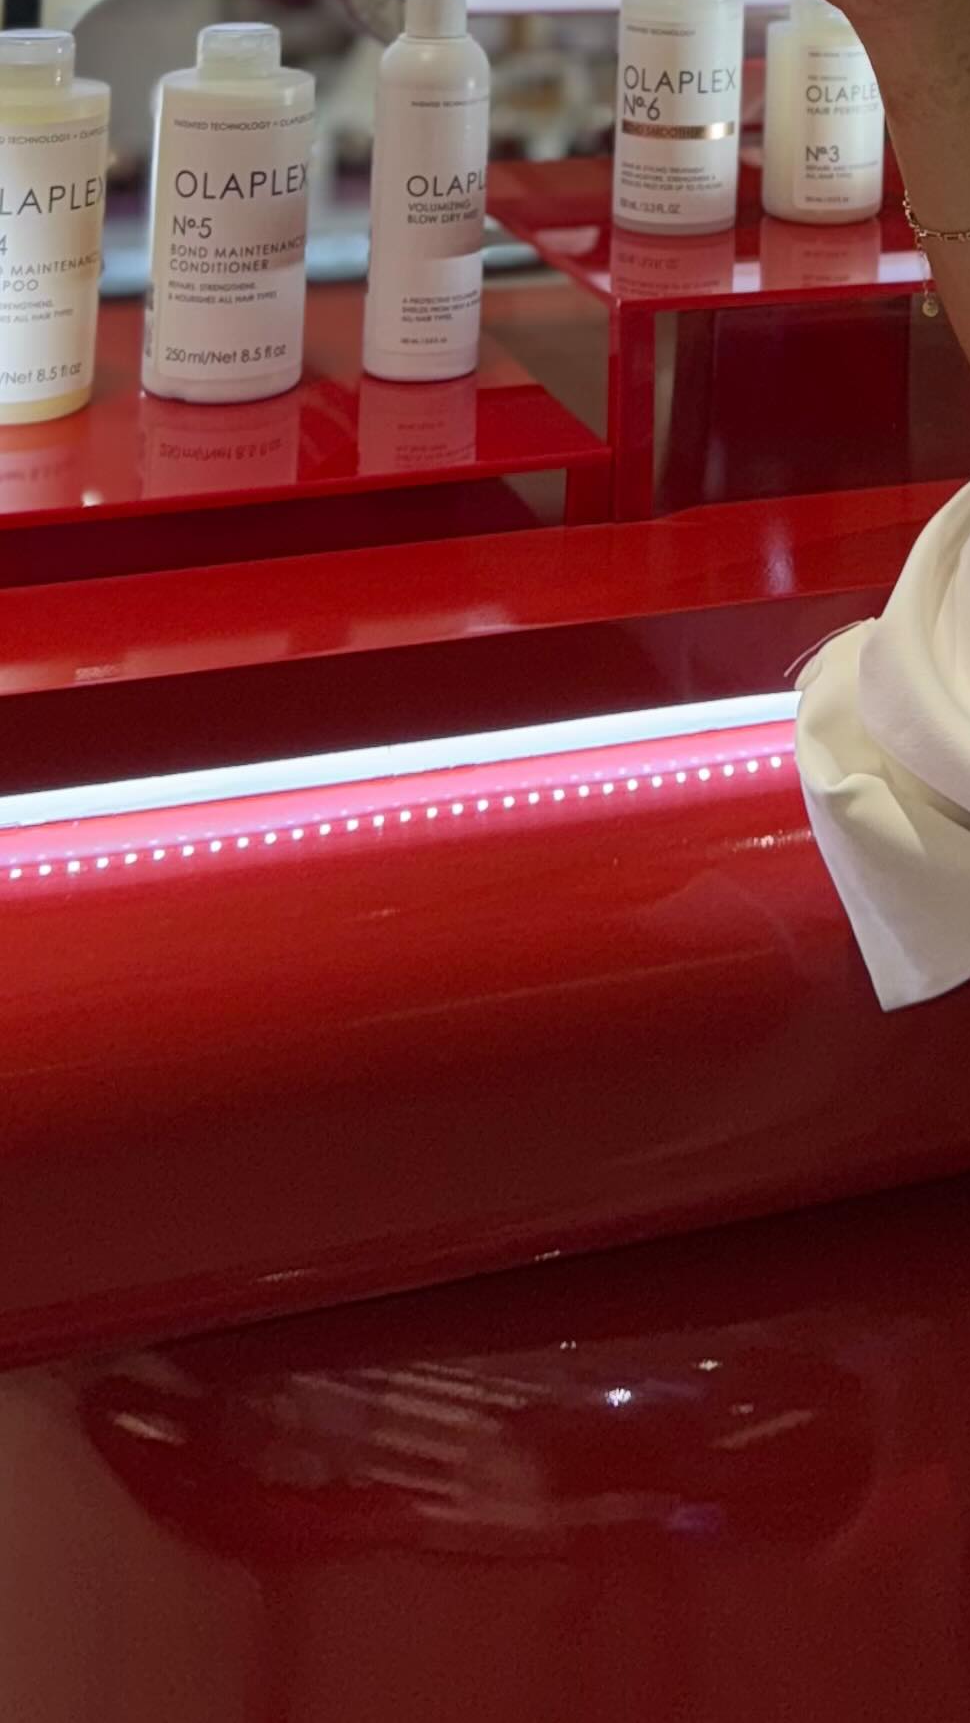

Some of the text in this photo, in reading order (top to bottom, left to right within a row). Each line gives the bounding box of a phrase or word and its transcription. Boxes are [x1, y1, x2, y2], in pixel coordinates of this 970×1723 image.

[623, 64, 737, 94] OLAPLEX
[806, 82, 880, 104] OLAPLE
[407, 213, 438, 225] BLOW
[171, 243, 208, 259] BOND
[169, 258, 270, 274] CONDITIONER
[240, 349, 262, 364] 8.5
